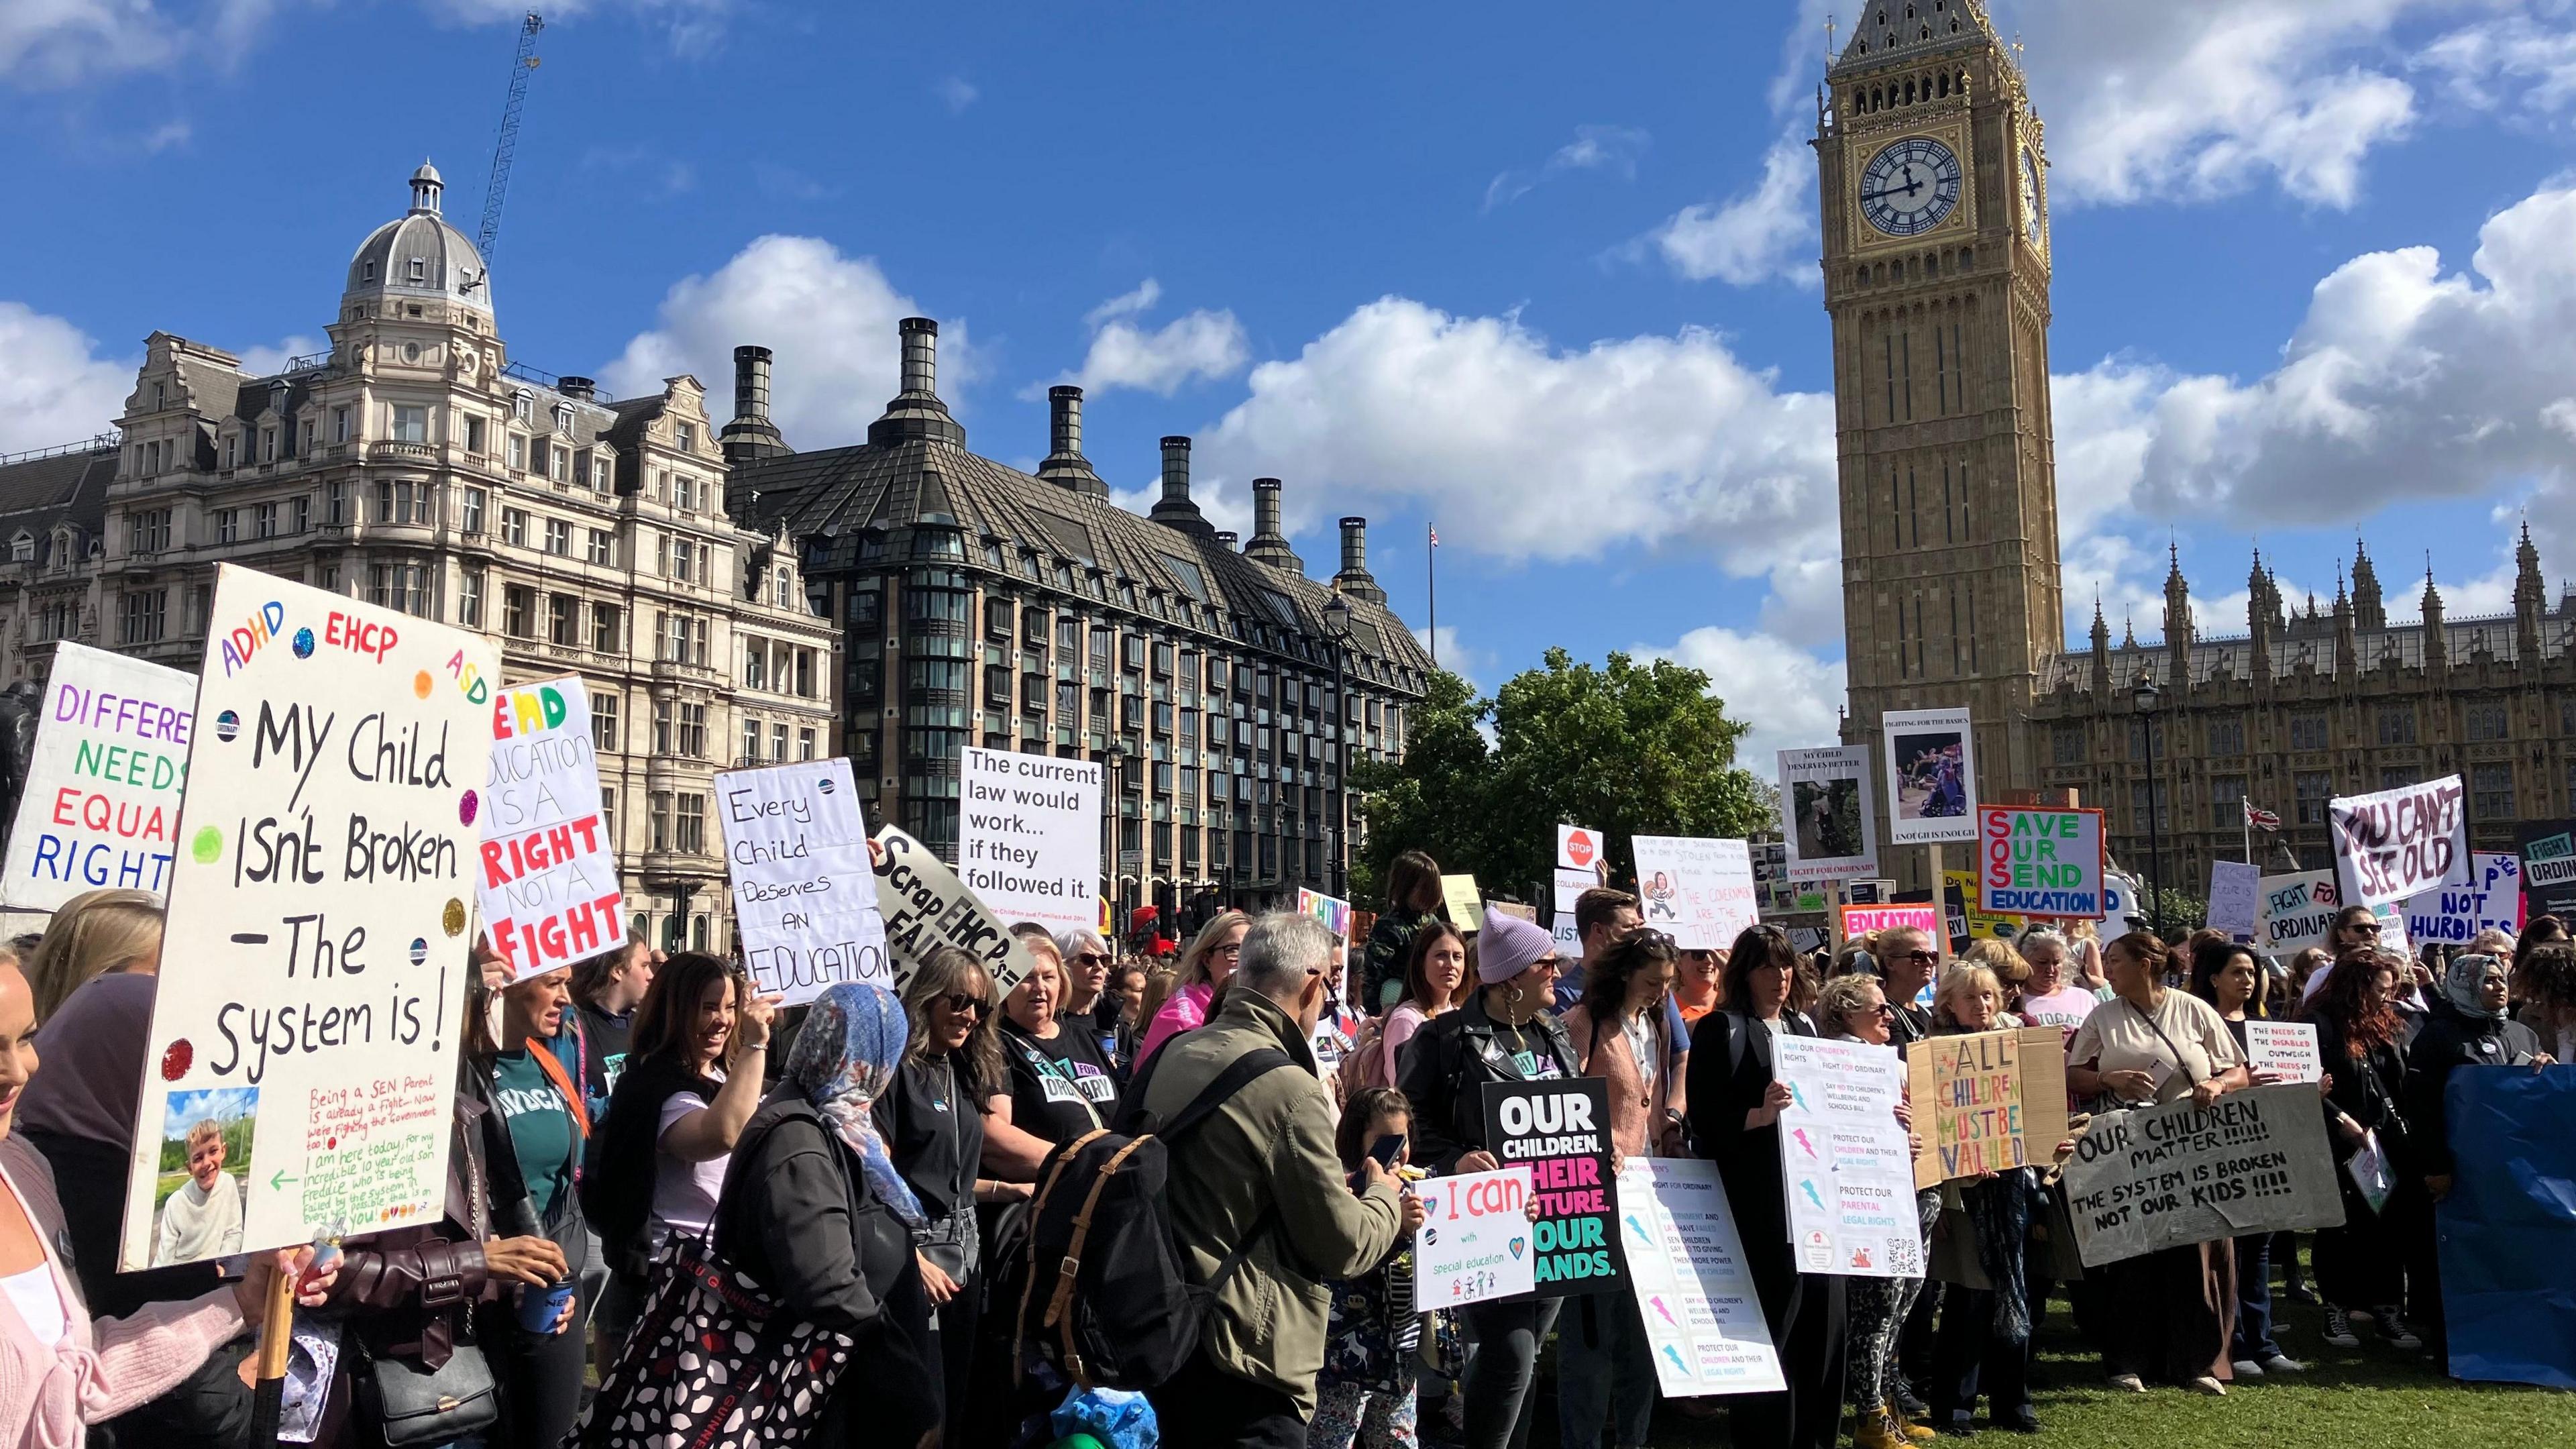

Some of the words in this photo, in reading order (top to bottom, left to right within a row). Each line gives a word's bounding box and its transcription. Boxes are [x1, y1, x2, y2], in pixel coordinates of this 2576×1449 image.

[221, 601, 284, 678] ADHD
[325, 610, 398, 664] EHCP
[446, 649, 487, 705] ASD
[1885, 719, 1917, 729] FIGHTING
[1917, 718, 1931, 727] FOR
[1931, 718, 1945, 726] THE
[1945, 717, 1970, 725] BASICS
[253, 700, 335, 812] My
[1787, 761, 1828, 771] DESERVES
[1828, 759, 1860, 769] BETTER
[1804, 751, 1815, 759] MY
[1816, 750, 1842, 759] CHILD
[969, 750, 1012, 774] The
[1018, 761, 1098, 786] current
[487, 789, 524, 828] IS
[534, 782, 564, 822] A
[728, 788, 812, 824] Every
[969, 780, 1006, 803] law
[1014, 788, 1080, 811] would
[969, 814, 1044, 836] work...
[1895, 831, 1930, 841] ENOUGH
[1931, 830, 1939, 839] IS
[1940, 829, 1976, 839] ENOUGH
[1986, 811, 2079, 839] SAVE
[343, 812, 457, 880] Broken
[479, 814, 599, 891] RIGHT
[969, 839, 984, 859] if
[989, 842, 1038, 869] they
[1568, 841, 1592, 855] STOP
[1990, 839, 2058, 863] OUR
[2531, 837, 2570, 860] FIGHT
[31, 834, 172, 891] RIGHT
[1789, 867, 1815, 877] FIGHT
[1815, 866, 1832, 875] FOR
[1833, 863, 1876, 873] ORDINARY
[1988, 862, 2082, 888] SEND
[2359, 851, 2398, 897] SEE
[2403, 837, 2453, 888] OLD
[2493, 856, 2518, 877] SEN
[506, 869, 555, 914] NOT
[567, 862, 595, 901] A
[873, 835, 945, 922] Scrap
[967, 868, 1064, 898] followed
[1071, 877, 1090, 900] it.
[1682, 887, 1702, 906] THE
[1991, 890, 2096, 912] EDUCATION
[2270, 883, 2308, 914] FIGHT
[2441, 892, 2487, 914] NOT
[782, 912, 809, 931] AN
[1000, 908, 1024, 917] Children
[1038, 911, 1063, 920] Families
[1073, 914, 1087, 922] 2014
[1299, 890, 1349, 936] FIGHTING
[1695, 908, 1715, 920] ARE
[1847, 910, 1937, 934] EDUCATION
[492, 892, 622, 975] FIGHT
[748, 939, 891, 994] EDUCATION
[210, 1002, 371, 1084] System
[2271, 1028, 2296, 1036] NEEDS
[1782, 1042, 1799, 1051] SAVE
[1800, 1044, 1815, 1053] OUR
[1815, 1046, 1850, 1057] CHILDREN'S
[1784, 1053, 1807, 1063] RIGHTS
[1956, 1036, 2013, 1077] ALL
[1078, 1065, 1097, 1075] FOR
[1822, 1062, 1841, 1071] FIGHT
[1841, 1063, 1854, 1071] FOR
[1854, 1065, 1886, 1075] ORDINARY
[2276, 1062, 2300, 1070] NEEDS
[310, 1087, 347, 1110] Being
[354, 1087, 363, 1099] a
[371, 1078, 397, 1099] SEN
[404, 1073, 434, 1093] Parent
[1827, 1093, 1858, 1102] WELLBEING
[1858, 1095, 1871, 1103] AND
[1855, 1085, 1886, 1095] CHILDREN'S
[1939, 1073, 2019, 1108] CHILDREN
[309, 1109, 320, 1124] is
[326, 1106, 364, 1126] already
[415, 1093, 436, 1105] Now
[1499, 1093, 1597, 1136] OUR
[1827, 1102, 1852, 1111] SCHOOLS
[1853, 1104, 1865, 1112] BILL
[370, 1116, 387, 1127] the
[1940, 1108, 1996, 1142] MUST
[1997, 1104, 2023, 1135] BE
[2078, 1124, 2133, 1164] OUR
[2145, 1099, 2259, 1142] CHILDREN
[1502, 1134, 1603, 1159] CHILDREN.
[1833, 1134, 1860, 1144] PROTECT
[1861, 1136, 1875, 1144] OUR
[1835, 1145, 1865, 1155] CHILDREN
[1866, 1147, 1880, 1156] AND
[1880, 1148, 1898, 1157] THEIR
[2131, 1131, 2222, 1169] MATTER
[1941, 1136, 2023, 1177] VALUED
[1839, 1185, 1874, 1197] PROTECT
[1875, 1187, 1892, 1197] OUR
[2073, 1192, 2105, 1214] THE
[2112, 1170, 2185, 1203] SYSTEM
[2192, 1165, 2209, 1182] IS
[2216, 1150, 2287, 1179] BROKEN
[1447, 1181, 1460, 1220] I
[1466, 1177, 1523, 1218] can
[1841, 1200, 1881, 1212] PARENTAL
[2094, 1210, 2131, 1232] NOT
[2141, 1193, 2180, 1216] OUR
[2191, 1178, 2247, 1207] KIDS
[1843, 1215, 1867, 1225] LEGAL
[1868, 1216, 1896, 1226] RIGHTS
[1460, 1232, 1478, 1244] with
[1433, 1259, 1462, 1276] special
[1466, 1252, 1505, 1269] education
